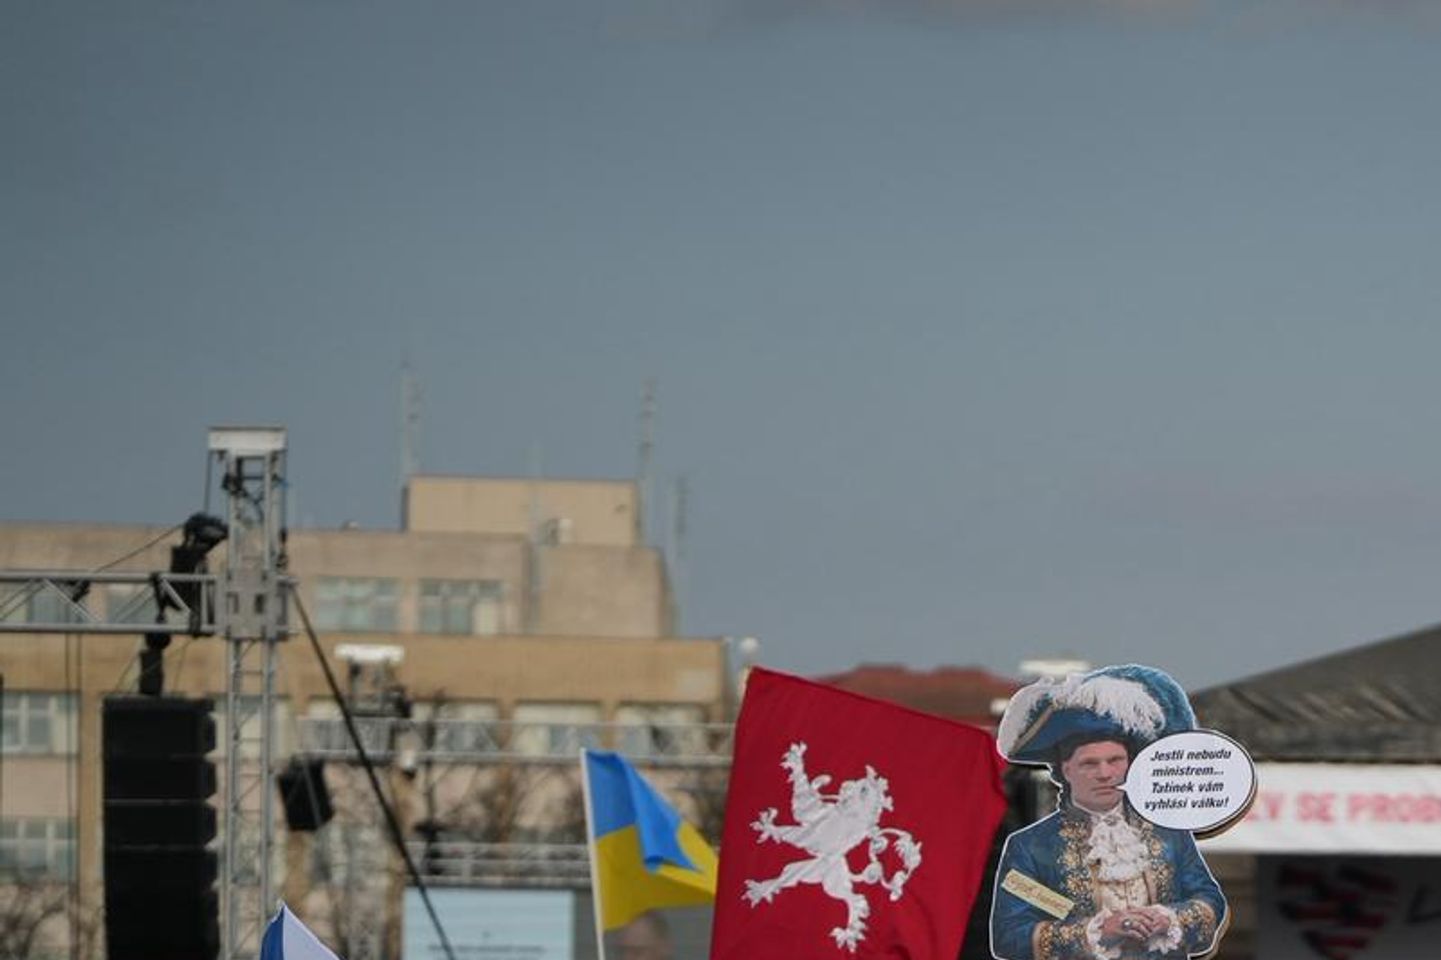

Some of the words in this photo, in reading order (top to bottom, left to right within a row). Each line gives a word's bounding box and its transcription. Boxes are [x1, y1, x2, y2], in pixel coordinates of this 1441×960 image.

[1150, 749, 1184, 761] Jestli
[1187, 748, 1232, 760] nebudu
[1198, 780, 1224, 793] vám
[1190, 796, 1229, 808] válku!
[1295, 792, 1335, 822] SE
